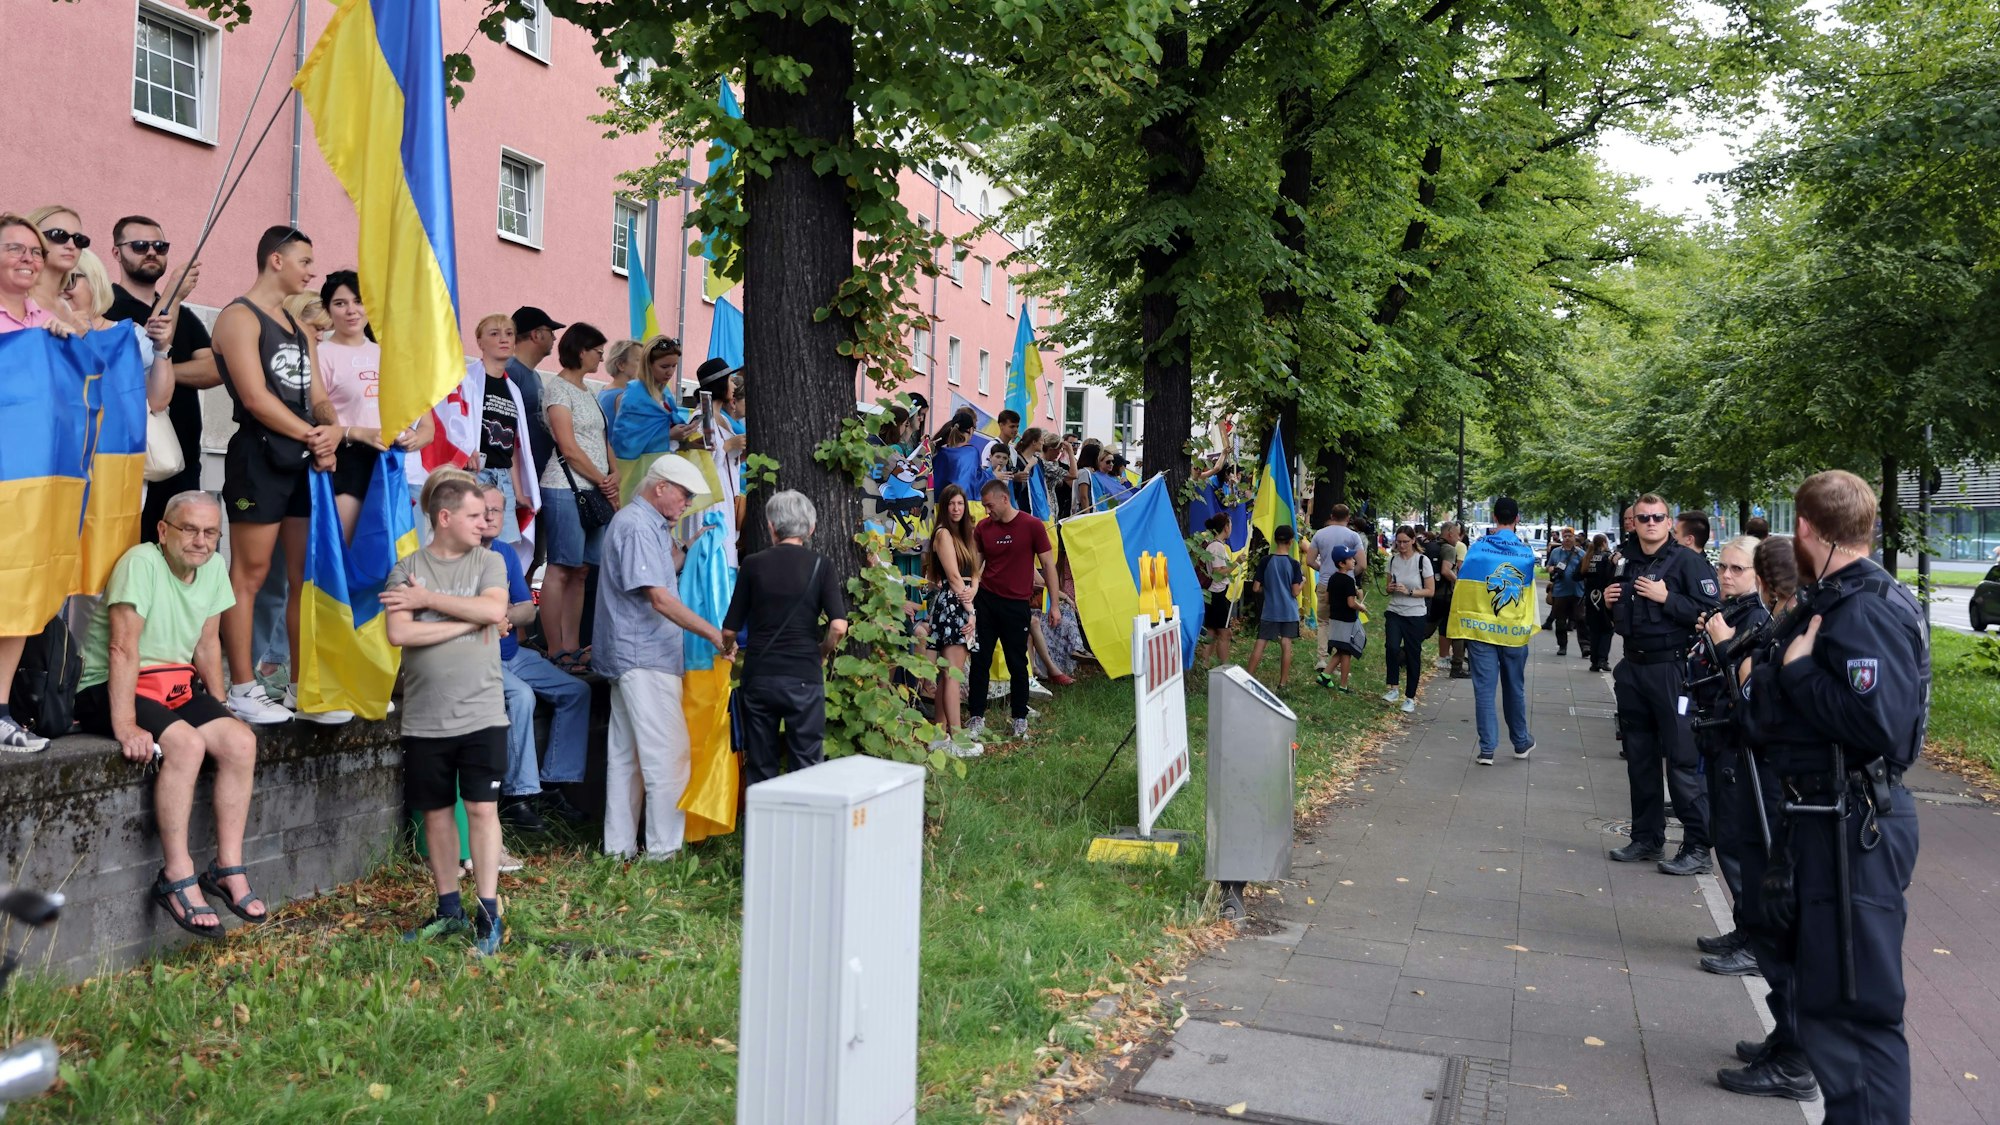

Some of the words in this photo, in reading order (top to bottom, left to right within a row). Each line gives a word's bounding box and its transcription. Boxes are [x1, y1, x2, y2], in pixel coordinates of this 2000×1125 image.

[1460, 618, 1508, 635] ГЕРОЯМ
[1511, 625, 1533, 636] СЛА
[1848, 660, 1877, 668] POLIZEI
[171, 684, 188, 694] NIKE
